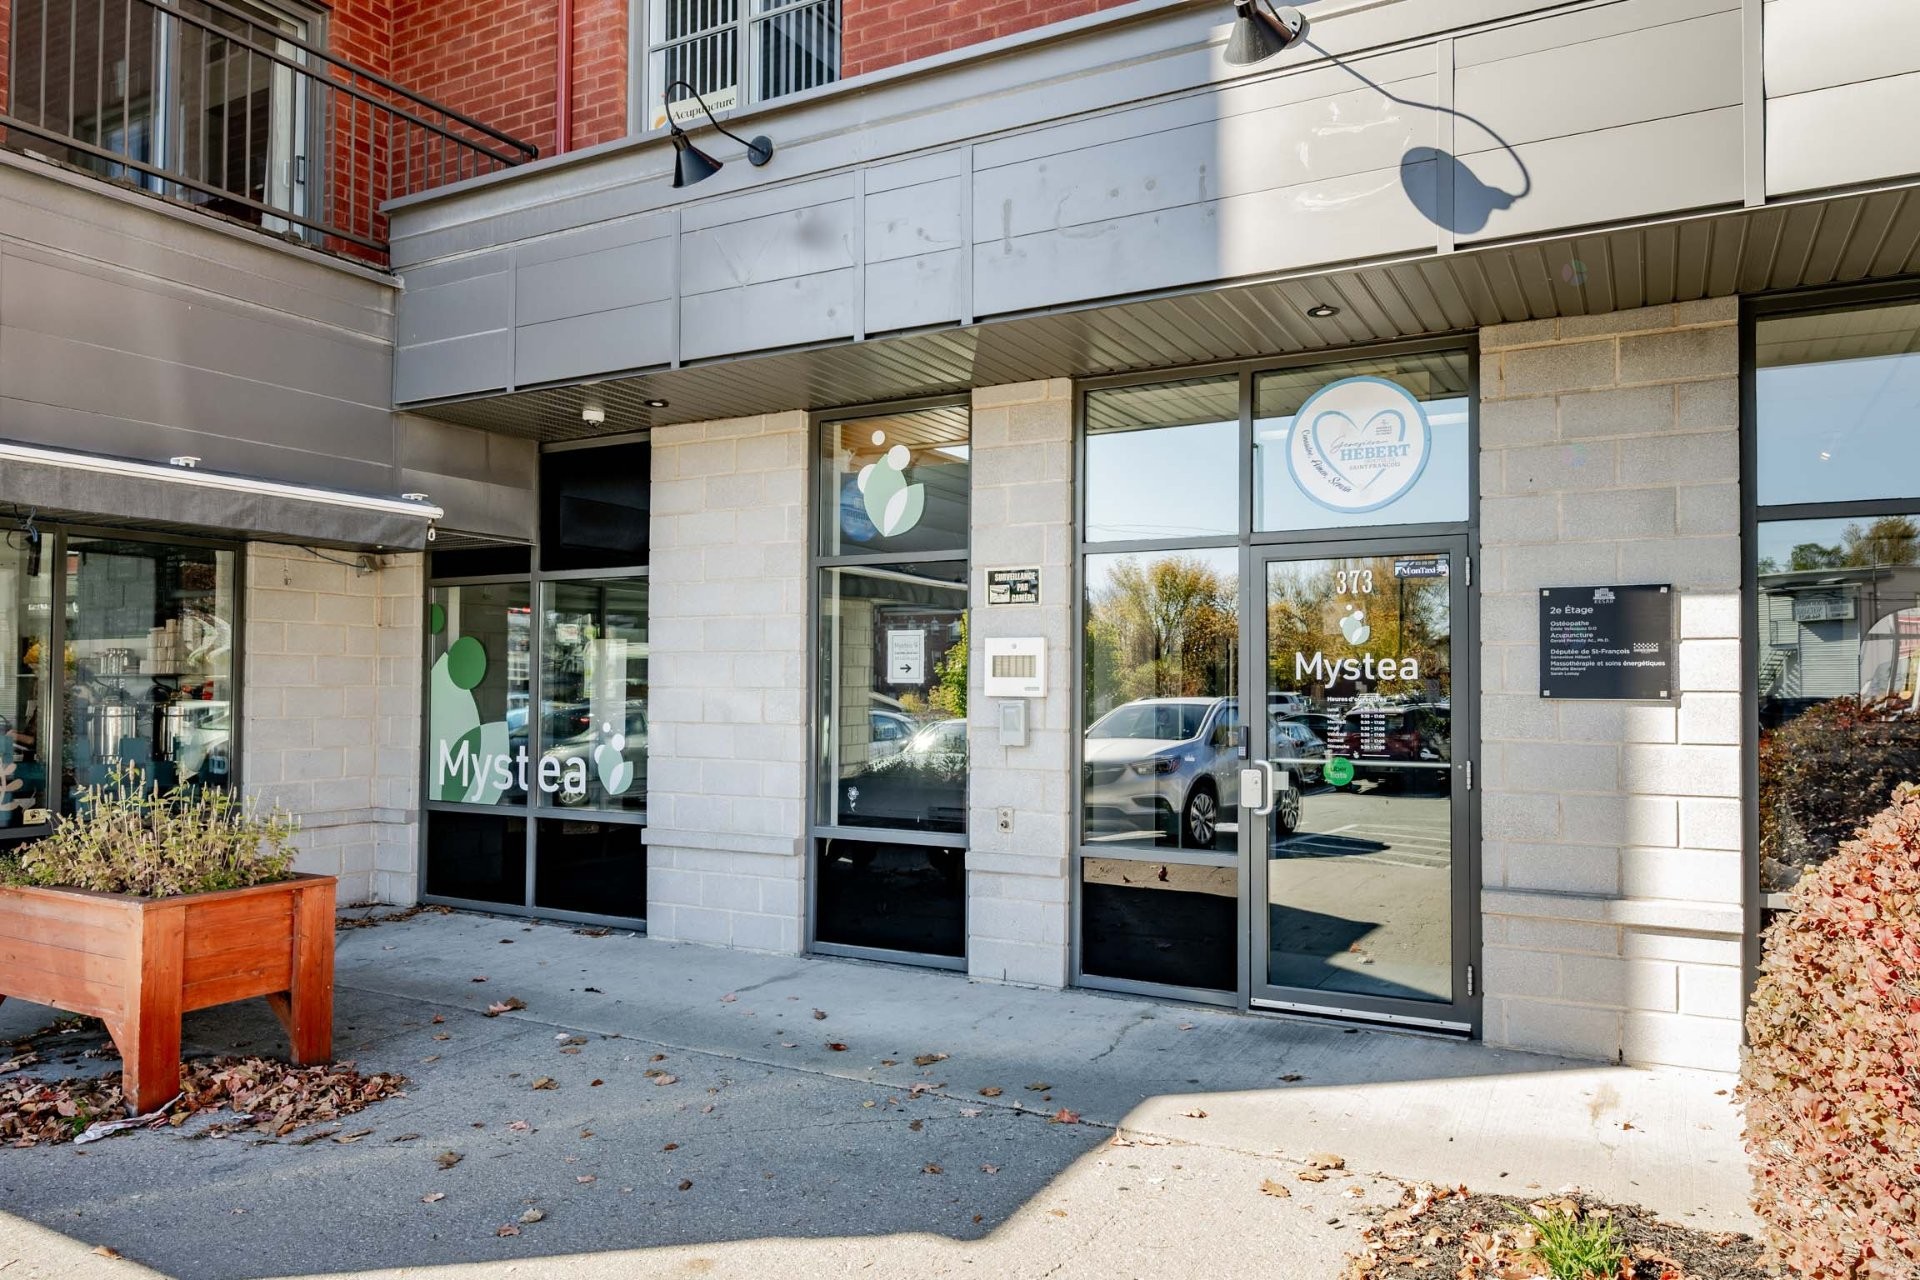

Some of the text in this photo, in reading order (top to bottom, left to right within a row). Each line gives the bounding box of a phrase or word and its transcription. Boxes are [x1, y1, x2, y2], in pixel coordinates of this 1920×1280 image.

[672, 97, 735, 121] Acupuncture
[994, 571, 1036, 582] SURVEILLANCE
[1336, 569, 1373, 595] 373
[1016, 582, 1029, 592] PAR
[1550, 604, 1594, 615] 2e Étage
[1295, 651, 1419, 689] Mystea
[1622, 660, 1666, 668] énergétiques
[438, 738, 588, 802] Mystea
